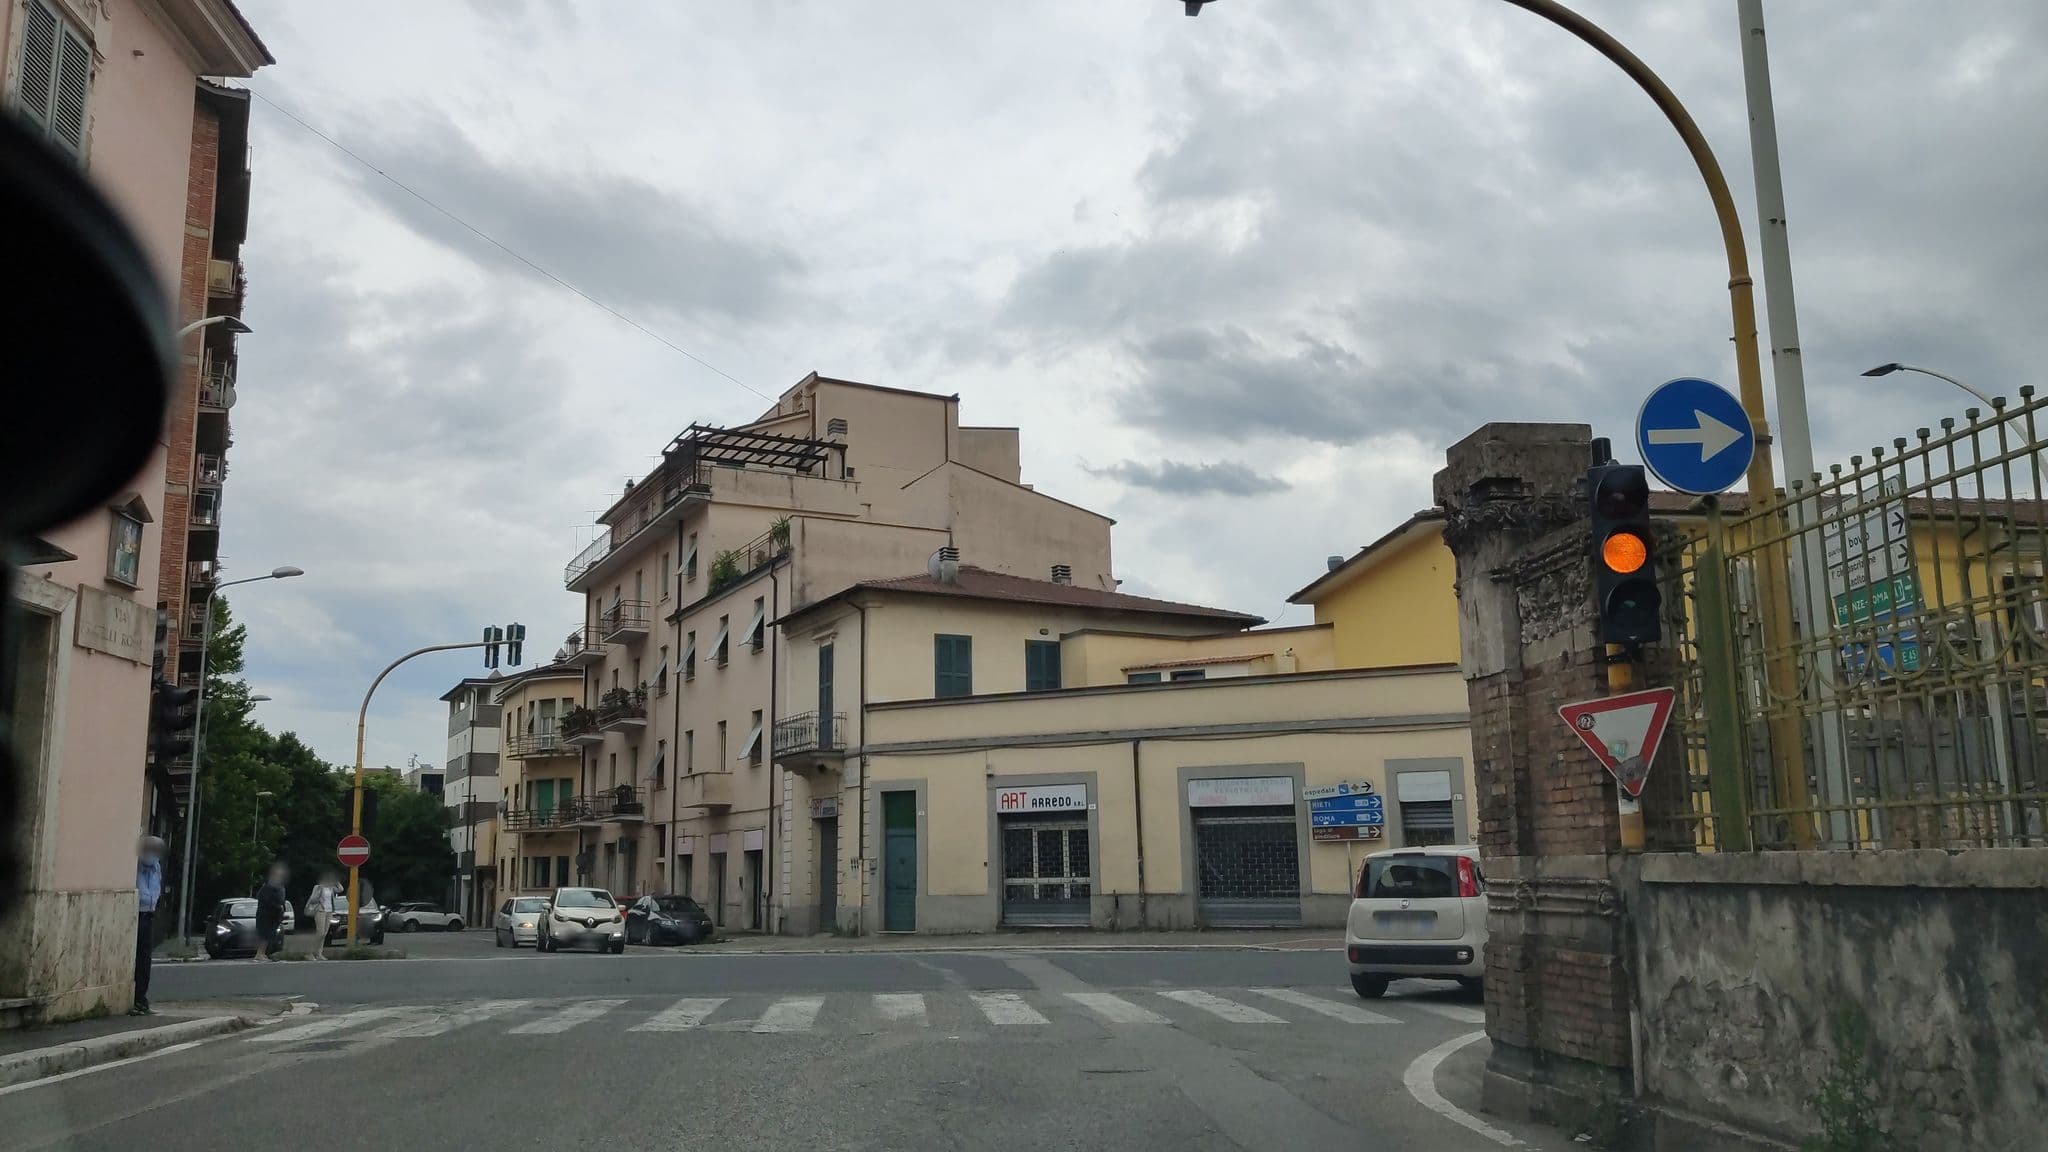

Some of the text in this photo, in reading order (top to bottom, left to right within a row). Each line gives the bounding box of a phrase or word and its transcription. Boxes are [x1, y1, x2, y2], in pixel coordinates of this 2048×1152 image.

[1848, 532, 1870, 549] bovo
[1908, 648, 1918, 660] 45
[1001, 792, 1027, 809] ART
[1032, 797, 1071, 808] ARREDO
[1314, 815, 1336, 823] ROMA
